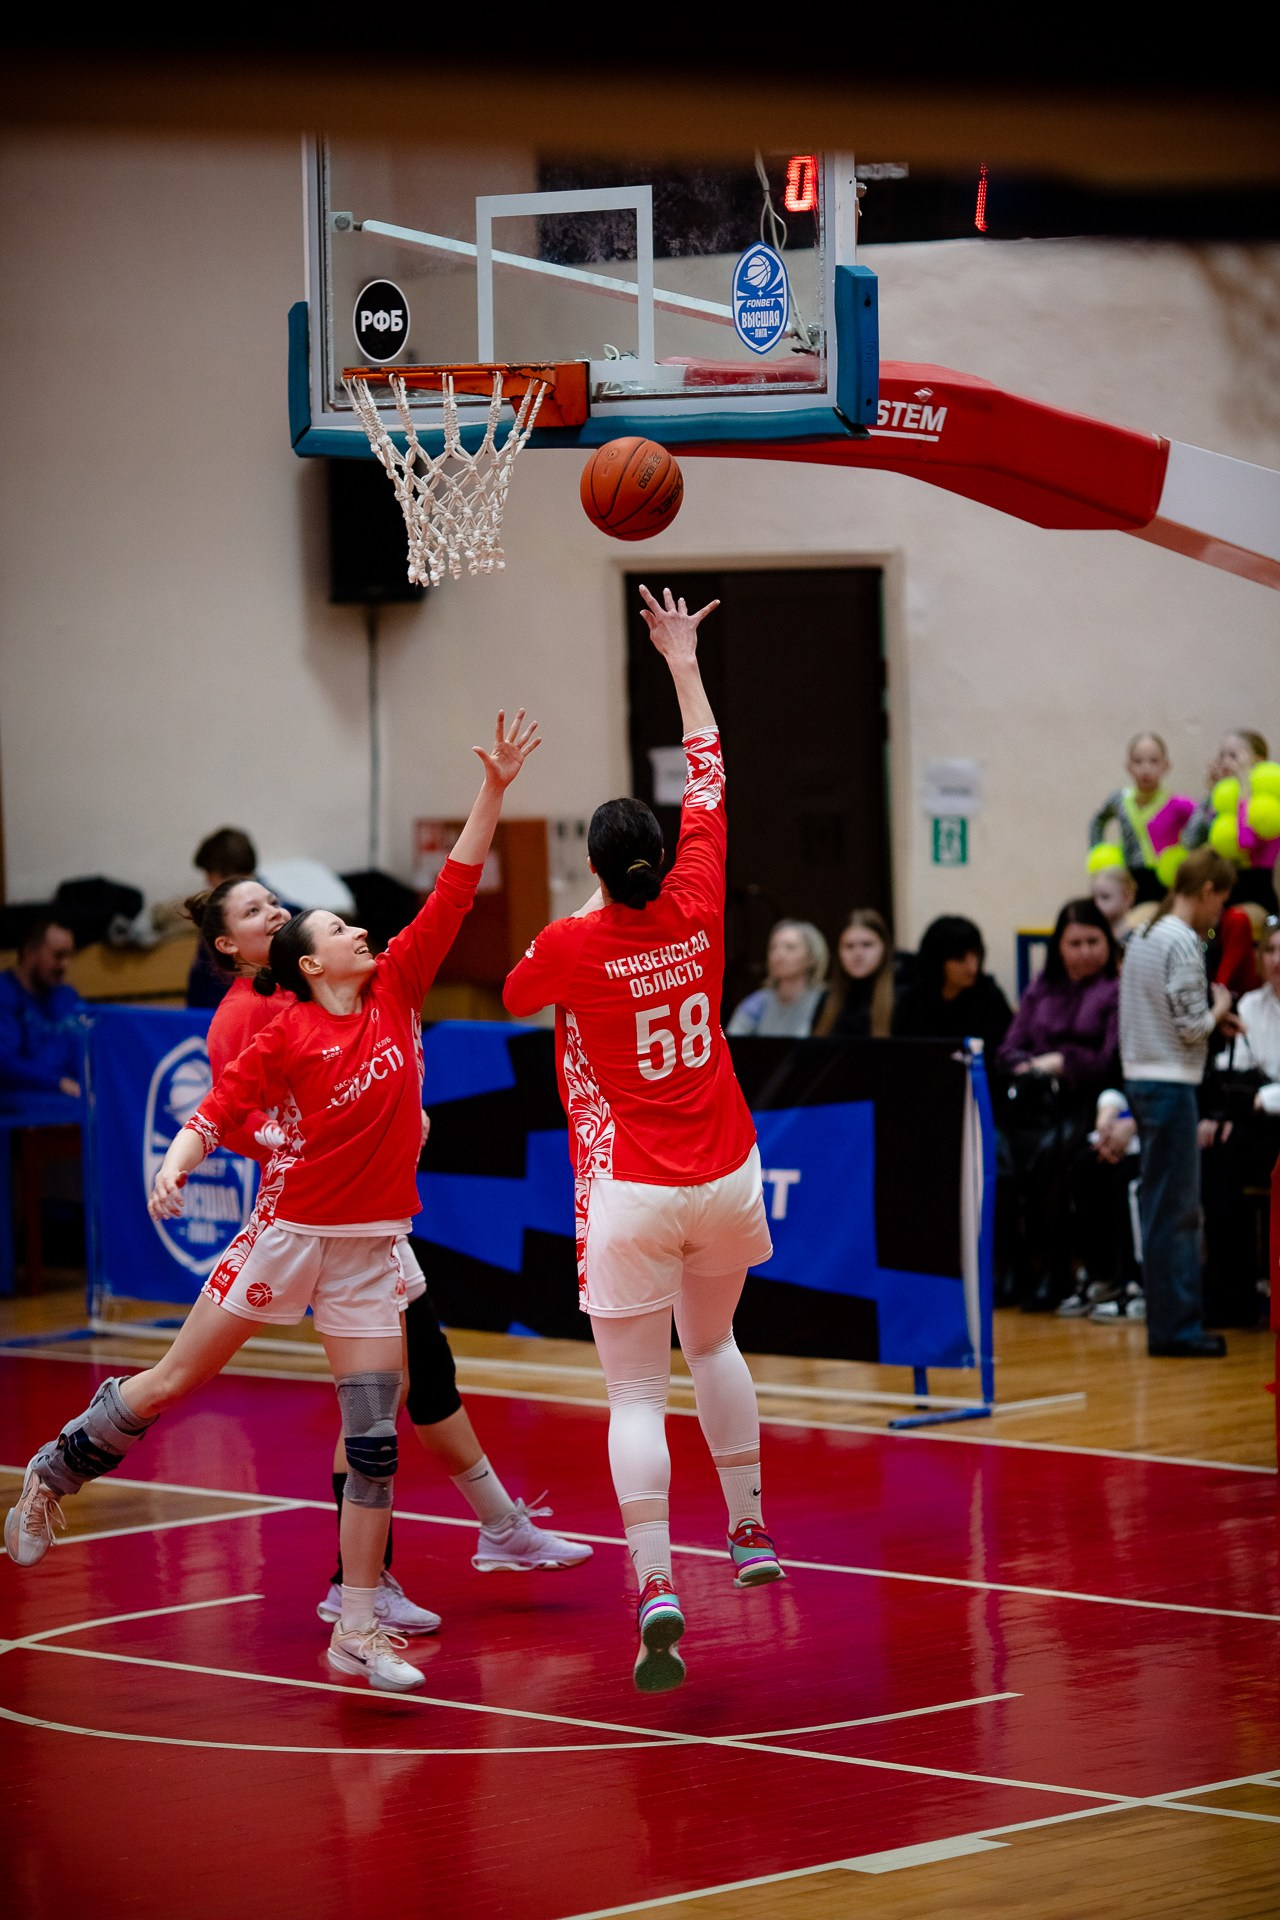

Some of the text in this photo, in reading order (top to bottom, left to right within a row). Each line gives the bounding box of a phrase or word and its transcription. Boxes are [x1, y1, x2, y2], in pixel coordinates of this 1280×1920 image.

[741, 310, 780, 328] ВЫСШАЯ
[746, 298, 776, 309] FONBET
[360, 309, 403, 332] РФБ
[604, 929, 711, 980] ПЕНЗЕНСКАЯ
[629, 960, 704, 999] ОБЛАСТЬ
[635, 992, 712, 1081] 58
